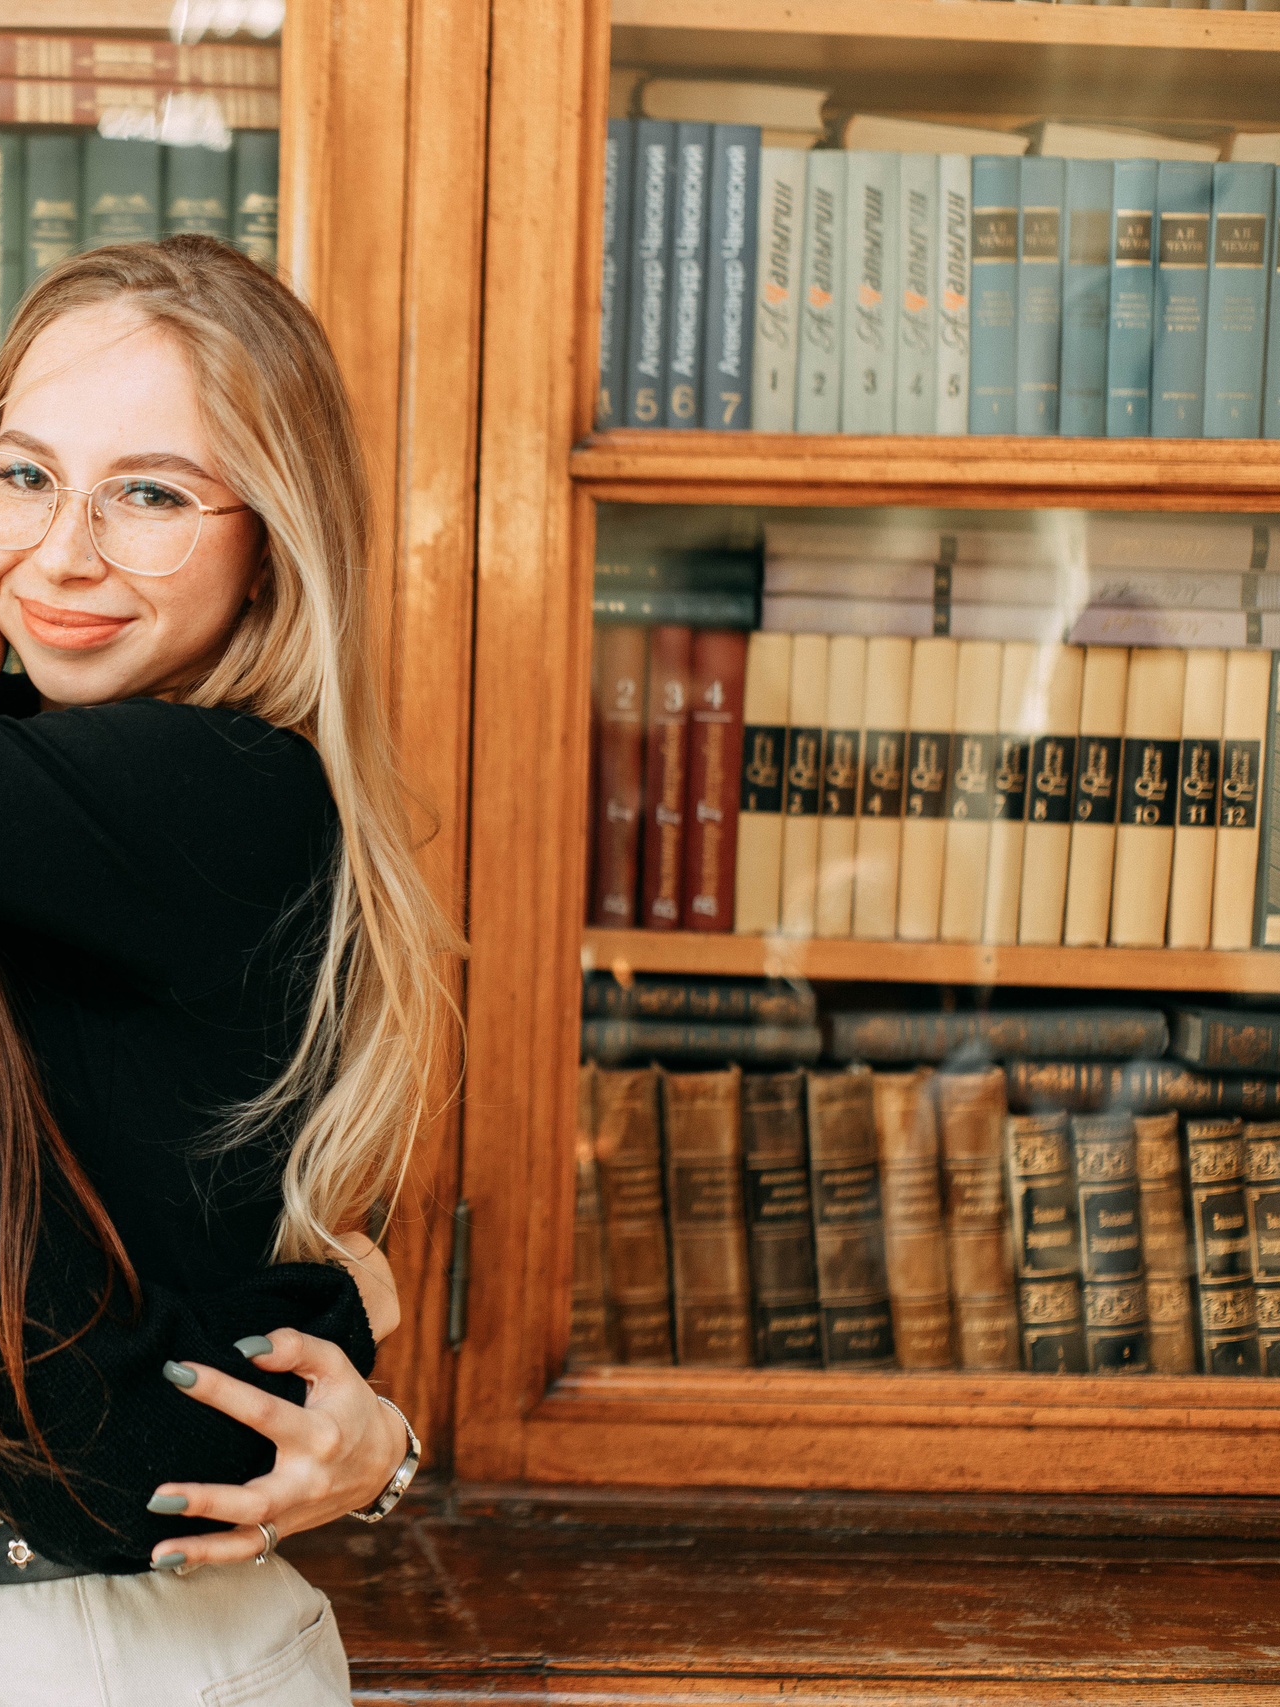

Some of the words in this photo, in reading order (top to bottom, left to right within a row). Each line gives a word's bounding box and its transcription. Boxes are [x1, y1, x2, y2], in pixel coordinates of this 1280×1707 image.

[765, 179, 793, 304] Чапыгин
[809, 186, 834, 308] Чапыгин
[859, 184, 884, 306] Чапыгин
[944, 189, 967, 311] Чапыгин
[862, 368, 877, 395] 3
[947, 374, 960, 398] 5
[635, 388, 658, 421] 5
[672, 384, 695, 418] 6
[720, 392, 742, 425] 7
[617, 677, 636, 710] 2
[664, 680, 684, 712] 3
[703, 679, 724, 710] 4
[789, 792, 804, 814] 2
[826, 791, 840, 813] 3
[868, 793, 883, 815] 4
[910, 793, 924, 817] 5
[953, 798, 968, 819] 6
[992, 794, 1007, 818] 7
[1033, 798, 1048, 821] 8
[1077, 798, 1093, 822] 9
[1132, 803, 1161, 826] 10
[1187, 804, 1208, 825] 11
[1223, 804, 1248, 827] 12
